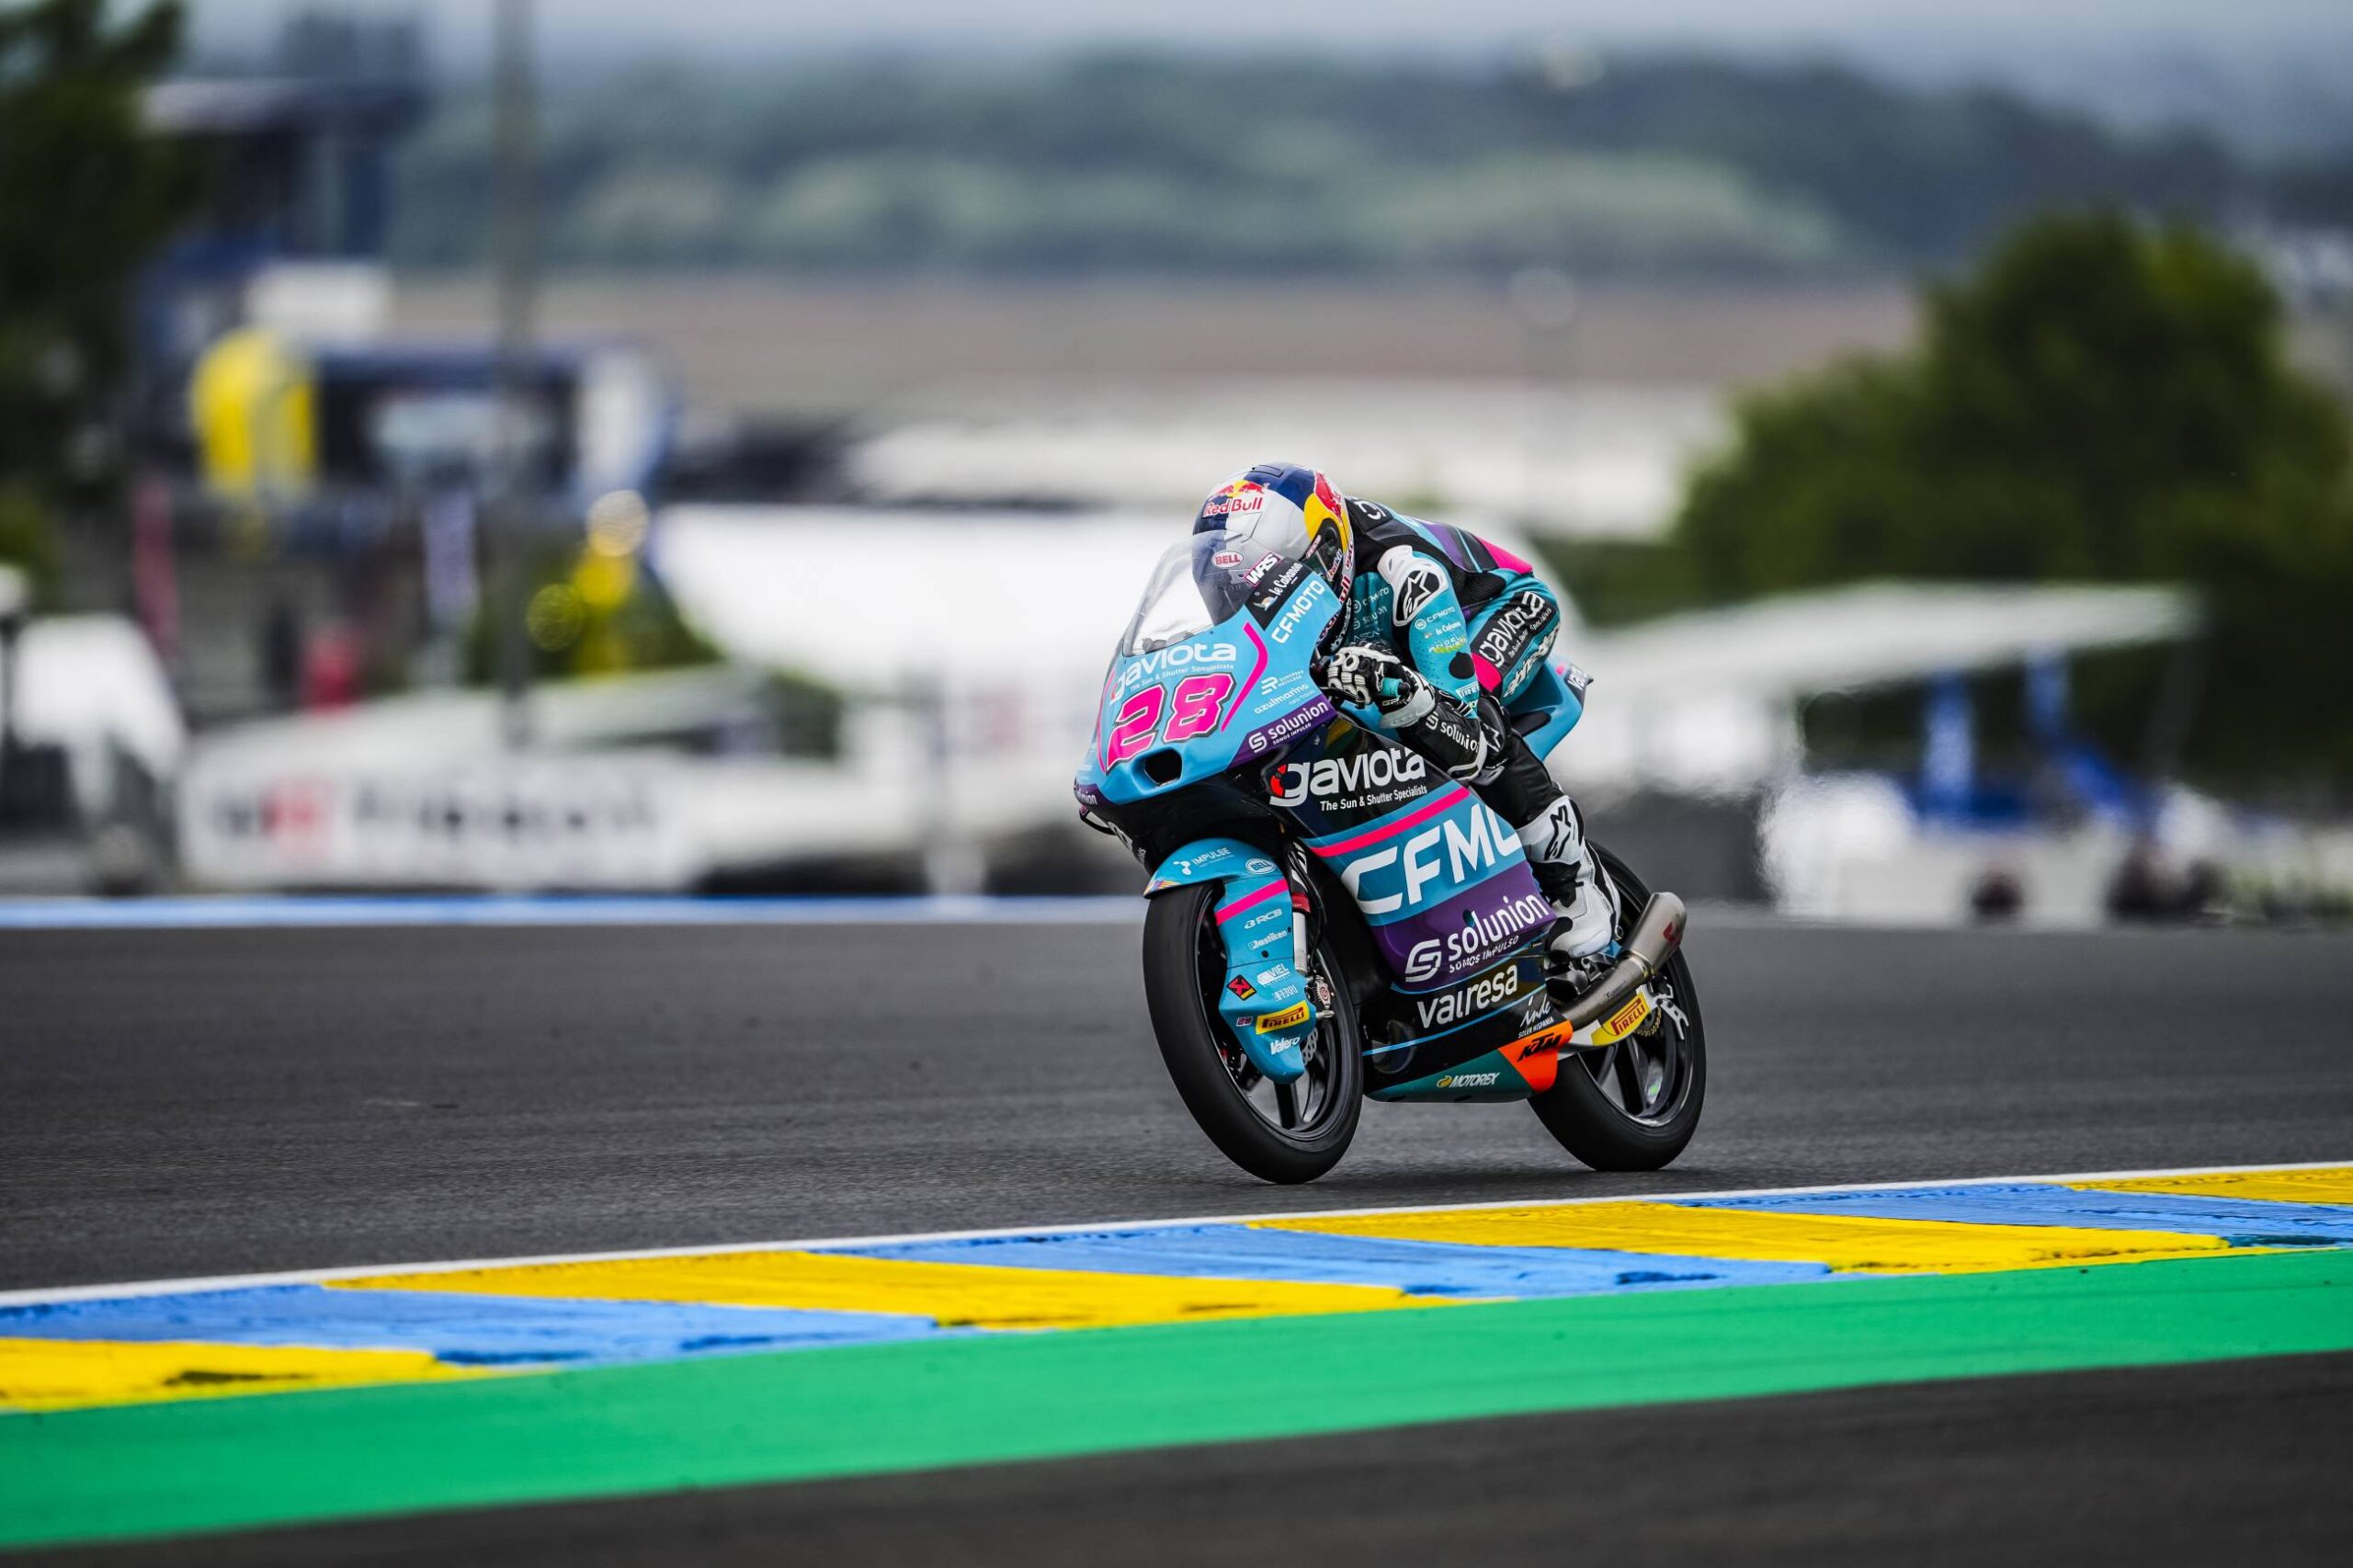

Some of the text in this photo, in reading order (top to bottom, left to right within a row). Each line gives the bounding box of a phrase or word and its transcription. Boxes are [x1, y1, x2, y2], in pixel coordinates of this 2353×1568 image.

[1203, 497, 1264, 517] Red Bull
[1214, 552, 1242, 565] BELL
[1245, 551, 1279, 585] WRS
[1271, 580, 1324, 643] CFMOTO
[1427, 606, 1456, 623] CFMOTO
[1479, 590, 1545, 667] gaviota
[1109, 643, 1236, 706] gaviota
[1162, 667, 1188, 678] Shutter
[1191, 664, 1234, 673] Specialists
[1254, 684, 1309, 714] azulmarino
[1106, 672, 1237, 775] 28
[1268, 701, 1329, 740] solunion
[1290, 723, 1312, 737] IMPULSO
[1269, 747, 1426, 807] gaviota
[1320, 785, 1428, 812] The Sun & Shutter Specialists
[1191, 847, 1232, 865] IMPULSE
[1251, 860, 1271, 871] BELL
[1256, 908, 1283, 925] RCB
[1447, 893, 1550, 962] solunion
[1449, 936, 1519, 973] SOMOS IMPULSO
[1262, 1006, 1305, 1029] PIRELLI
[1518, 1017, 1555, 1039] SOLER HISPANIA
[1610, 998, 1646, 1036] PIRELLI
[1518, 1032, 1563, 1062] KTM
[1449, 1072, 1500, 1088] MOTOREX
